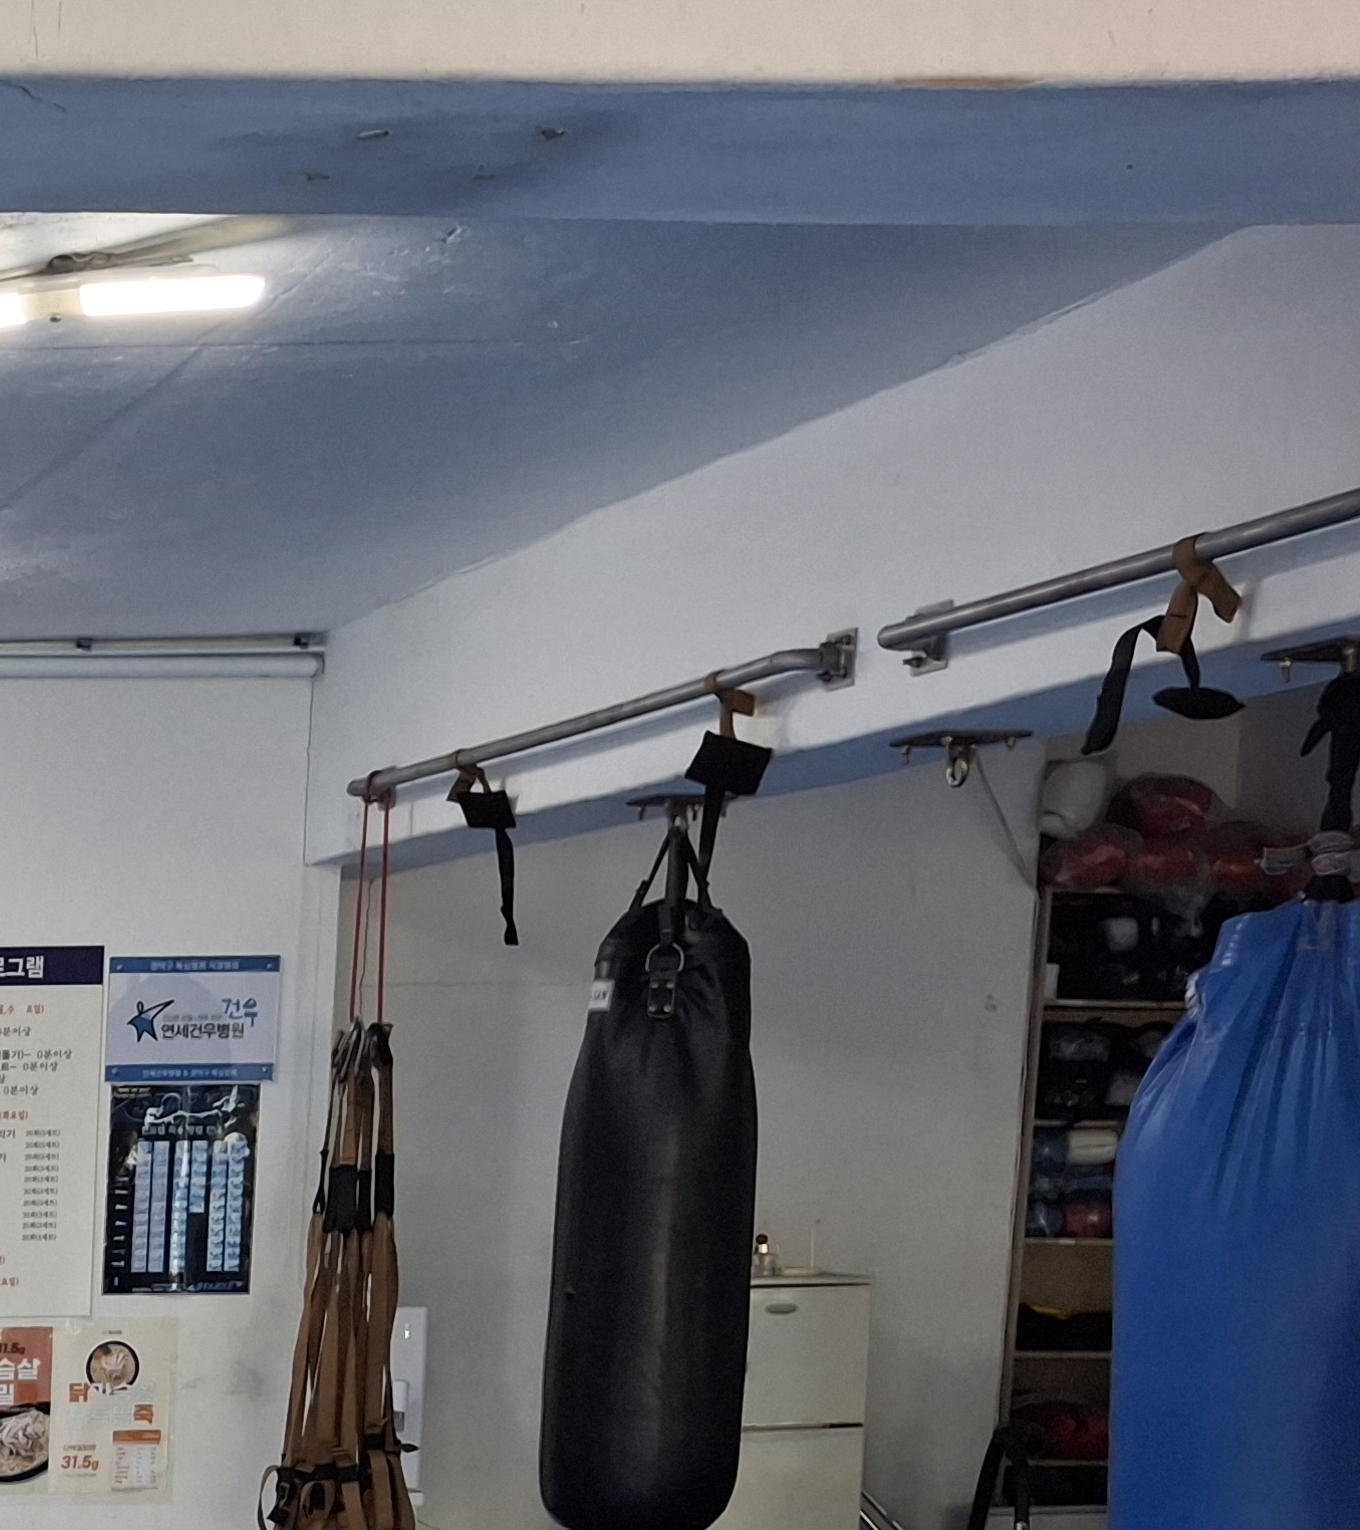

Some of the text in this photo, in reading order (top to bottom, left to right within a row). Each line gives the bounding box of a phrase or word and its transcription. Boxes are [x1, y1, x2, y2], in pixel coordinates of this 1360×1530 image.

[221, 998, 258, 1027] 건우
[161, 1023, 245, 1040] 연세건우병원
[61, 1454, 99, 1471] 31.5g
